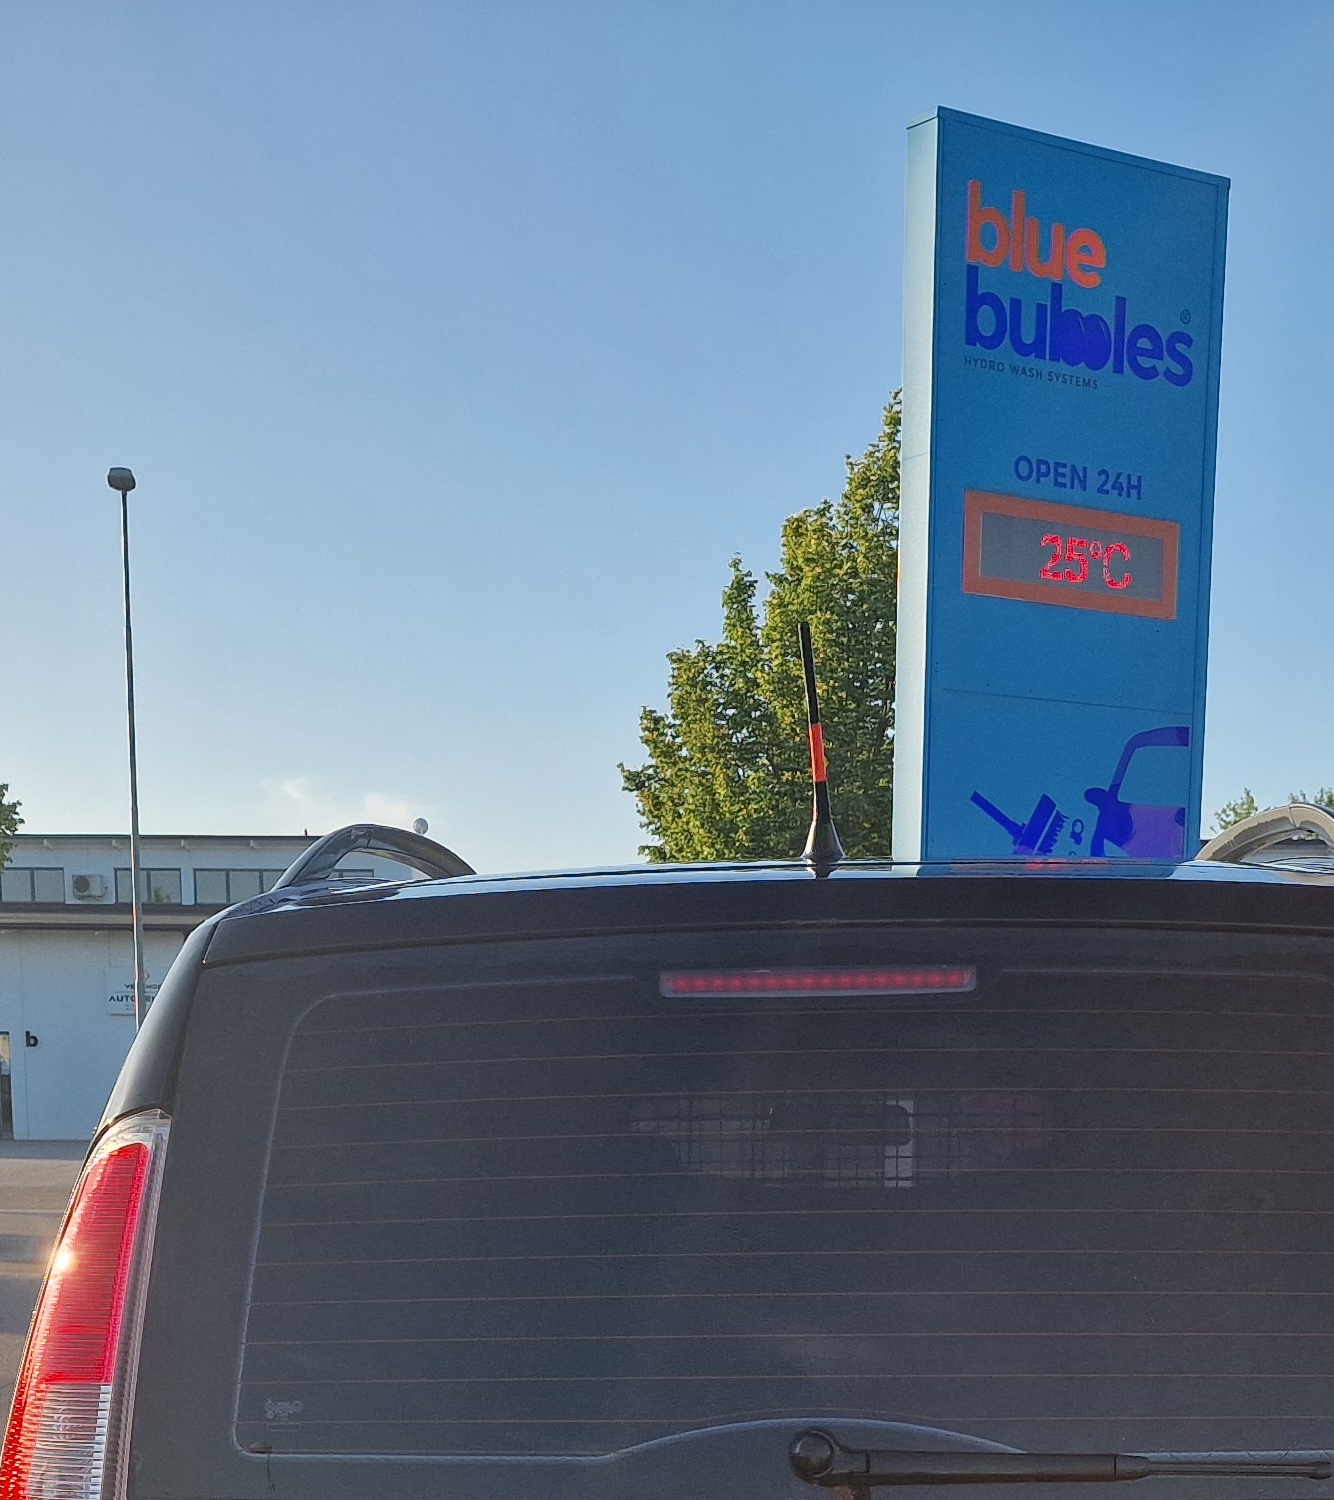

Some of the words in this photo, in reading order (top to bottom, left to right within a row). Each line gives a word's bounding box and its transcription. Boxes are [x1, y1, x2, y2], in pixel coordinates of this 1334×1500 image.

[966, 179, 1107, 288] blue
[965, 265, 1194, 387] bubbles
[964, 356, 1005, 372] HYDRO
[1009, 364, 1043, 380] WASH
[1047, 370, 1099, 390] SYSTEMS
[1014, 455, 1088, 492] OPEN
[1096, 468, 1143, 500] 24H
[1039, 534, 1133, 589] 25°C
[25, 1030, 38, 1047] b
